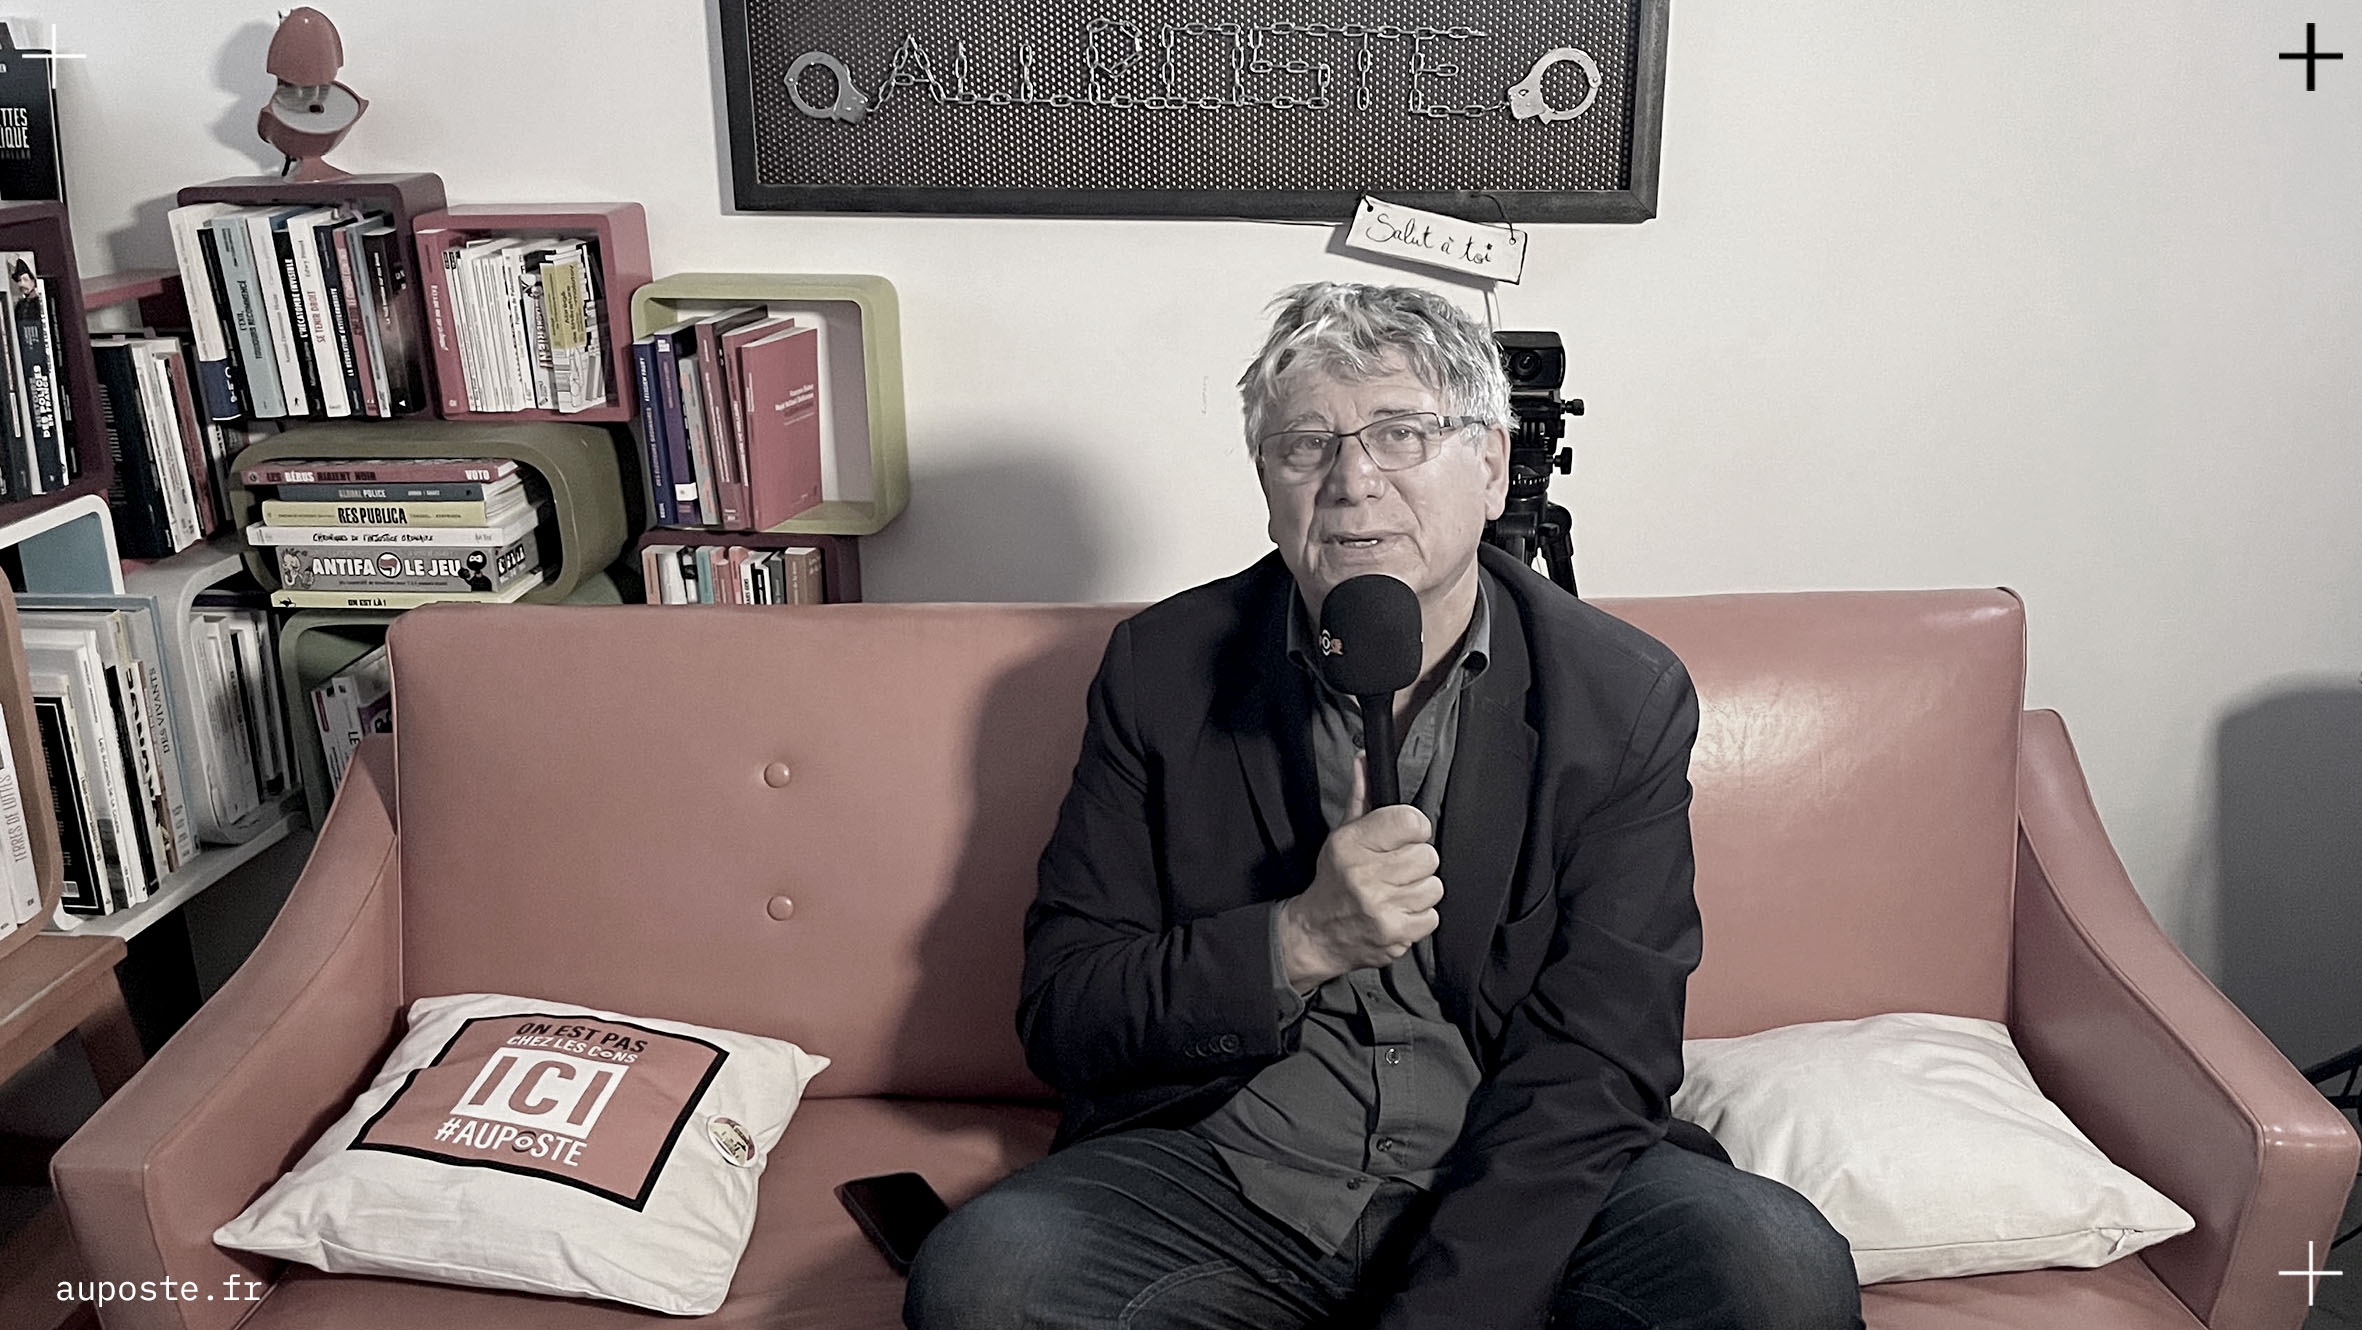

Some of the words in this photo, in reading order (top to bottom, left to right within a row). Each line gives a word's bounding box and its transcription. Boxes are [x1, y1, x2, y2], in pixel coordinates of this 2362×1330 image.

[0, 107, 28, 127] TTES
[1366, 213, 1434, 243] Salut
[1441, 236, 1454, 255] à
[1459, 235, 1493, 265] toi
[465, 469, 490, 481] VOTO
[362, 489, 386, 498] POLICE
[337, 507, 358, 524] RES
[360, 507, 408, 525] PUBLICA
[312, 557, 377, 577] ANTIFA
[403, 558, 425, 577] LE
[427, 558, 462, 577] JEU
[148, 667, 164, 726] VIVANTS
[158, 728, 170, 753] DES
[5, 811, 20, 825] DE
[8, 825, 27, 862] TERRES
[506, 1035, 554, 1048] CHEZ
[553, 1038, 588, 1054] LES
[516, 1022, 553, 1036] ON
[554, 1024, 601, 1041] EST
[600, 1032, 648, 1053] PAS
[468, 1056, 614, 1126] ICI
